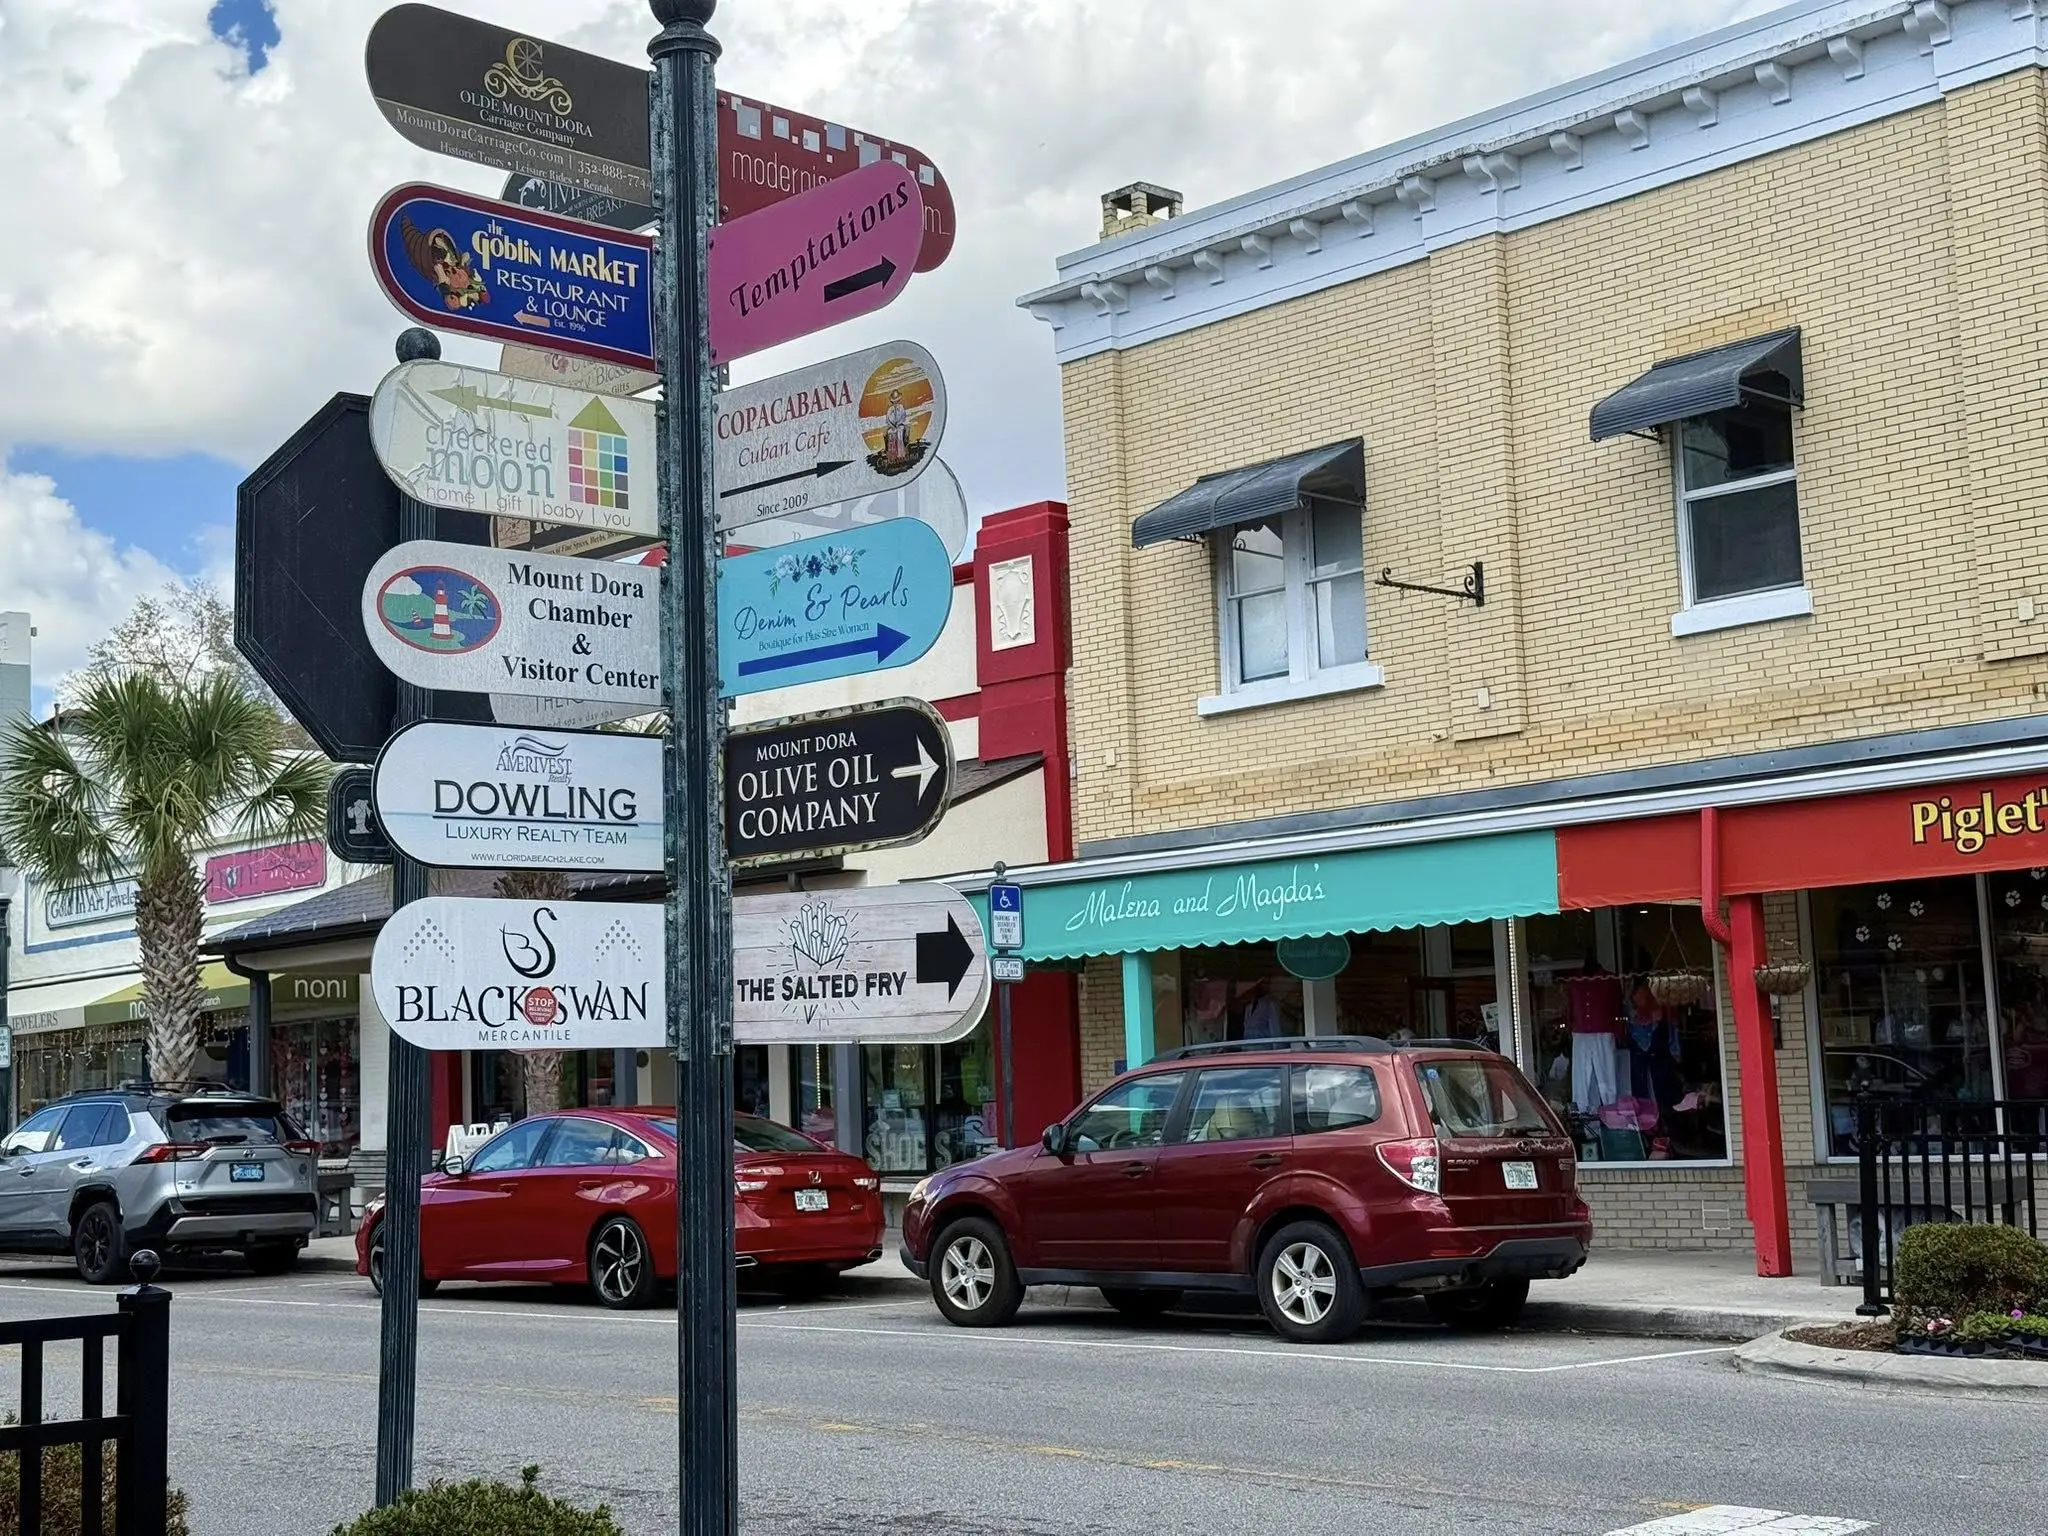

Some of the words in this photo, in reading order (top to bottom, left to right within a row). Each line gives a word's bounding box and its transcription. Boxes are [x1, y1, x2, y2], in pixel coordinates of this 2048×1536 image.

[460, 89, 501, 113] OLDE
[502, 101, 553, 127] MOUNT
[554, 116, 594, 138] DORA
[479, 109, 526, 133] Carriage
[527, 122, 577, 148] Company
[396, 107, 565, 165] MountDoraCarriageCo.com
[583, 177, 614, 196] Rentals
[729, 181, 910, 318] Temptations
[497, 269, 629, 313] RESTAURANT
[526, 297, 538, 312] &
[545, 300, 606, 328] LOUNGE
[569, 319, 586, 333] 1996
[717, 379, 852, 440] COPACABANA
[426, 422, 553, 464] checkered
[738, 436, 790, 468] Cuban
[426, 447, 555, 498] moon
[426, 483, 475, 505] home
[496, 494, 522, 513] gift
[543, 502, 584, 523] baby
[603, 512, 631, 528] you
[756, 500, 781, 518] Since
[782, 492, 809, 513] 2009
[508, 562, 584, 592] Mount
[591, 572, 645, 599] Dora
[528, 597, 633, 629] Chamber
[734, 606, 797, 640] Denim
[804, 583, 832, 622] &
[840, 565, 908, 621] Pearls
[571, 633, 592, 656] &
[758, 633, 792, 652] Boutique
[792, 632, 803, 646] for
[805, 628, 821, 643] Plus
[821, 626, 837, 640] Size
[838, 622, 870, 637] Women
[502, 655, 579, 683] Visitor
[586, 662, 660, 690] Center
[496, 750, 573, 775] AMERIVEST
[756, 738, 811, 762] MOUNT
[815, 731, 858, 752] DORA
[737, 761, 818, 802] OLIVE
[828, 753, 880, 789] OIL
[434, 779, 638, 821] DOWLING
[738, 792, 881, 840] COMPANY
[445, 823, 512, 841] LUXURY
[517, 825, 579, 844] REALTY
[583, 828, 628, 845] TEAM
[1065, 880, 1161, 931] Malena
[1173, 876, 1213, 914] and
[1215, 863, 1326, 922] Magda's
[294, 979, 347, 998] noni
[395, 985, 532, 1027] BLACK
[551, 980, 650, 1027] SWAN
[528, 997, 555, 1007] STOP
[737, 978, 775, 1002] THE
[781, 973, 859, 1001] SALTED
[865, 971, 908, 997] FRY
[11, 1011, 59, 1032] JEWELERS
[478, 1029, 572, 1041] MERCANTILE
